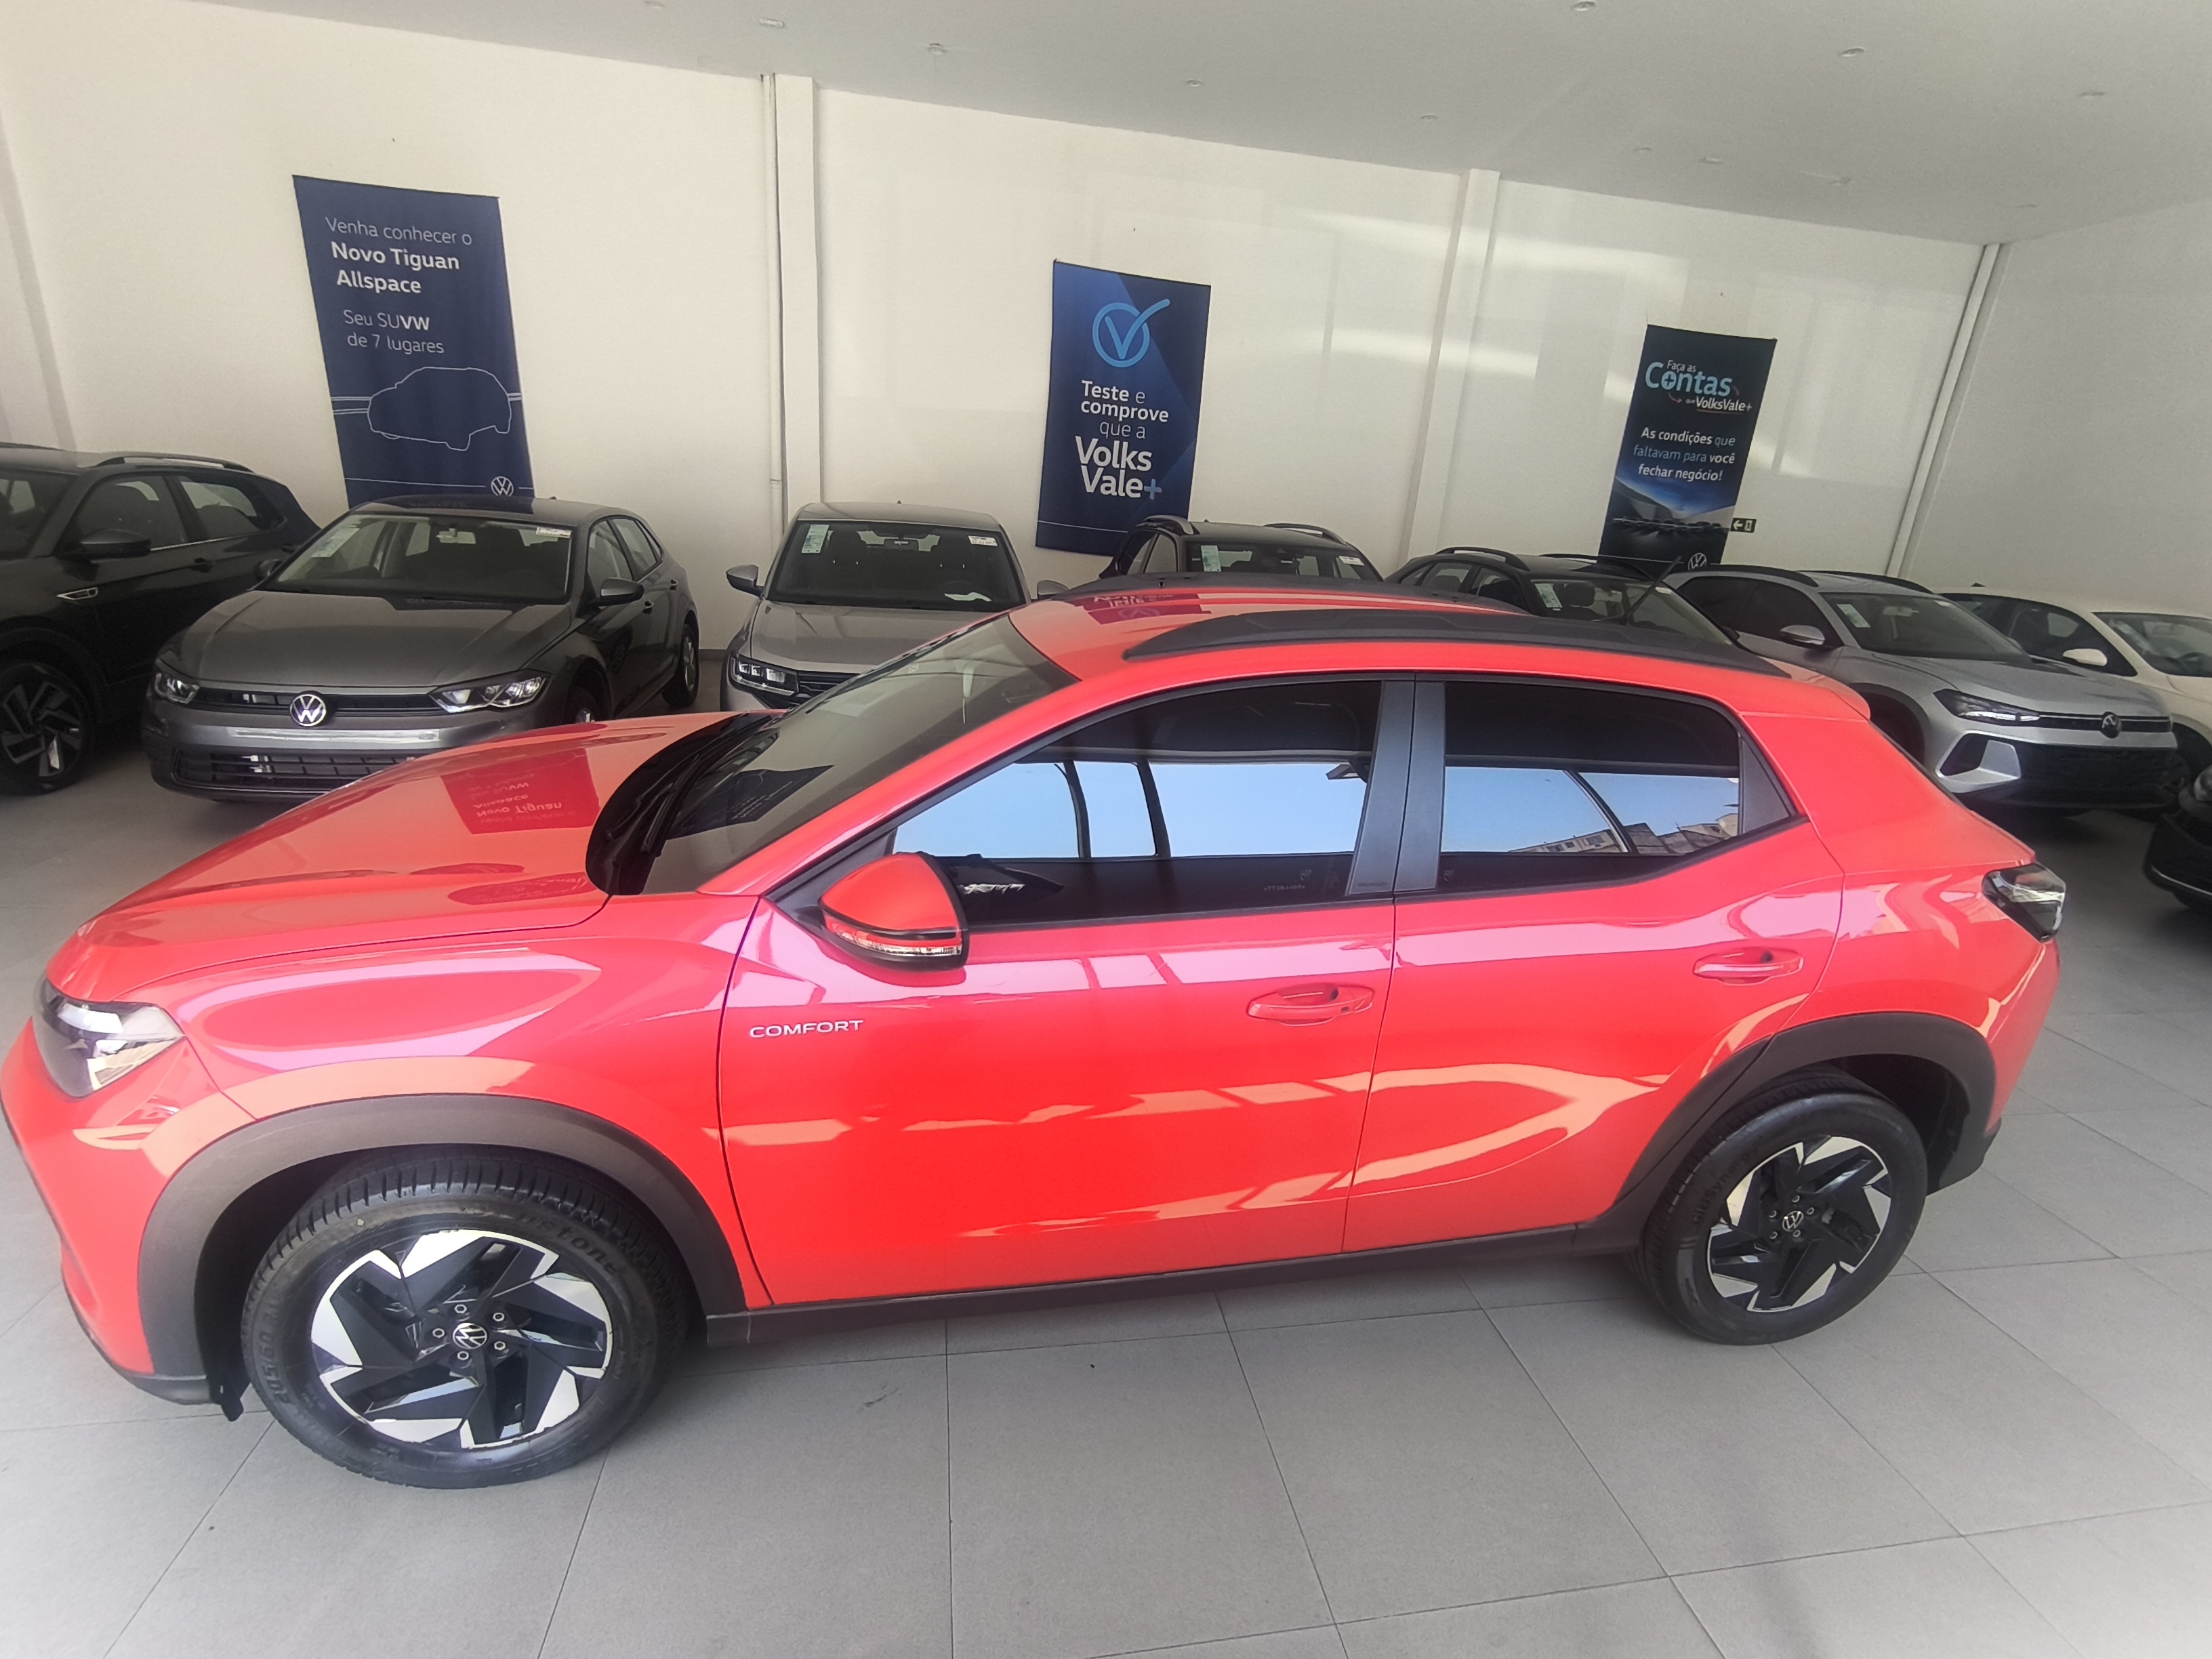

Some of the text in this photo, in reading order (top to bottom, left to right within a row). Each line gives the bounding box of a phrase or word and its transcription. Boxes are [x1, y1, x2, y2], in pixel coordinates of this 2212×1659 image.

[325, 217, 472, 245] Venha conhecer o
[331, 241, 459, 270] Novo Tiguan
[337, 269, 422, 293] Allspace
[344, 310, 430, 330] Seu SUVW
[347, 332, 444, 354] de 7 lugares
[1666, 360, 1696, 373] Faça as
[1645, 362, 1733, 396] Contas
[1082, 380, 1145, 404] Teste e
[1081, 401, 1169, 422] comprove
[1099, 421, 1145, 439] que a
[1641, 427, 1736, 449] As condições que
[1075, 436, 1152, 472] Volks
[1633, 445, 1735, 464] faltavam para você
[1638, 464, 1723, 482] fechar negócio!
[289, 693, 327, 726] VW
[750, 1019, 864, 1038] COMFORT
